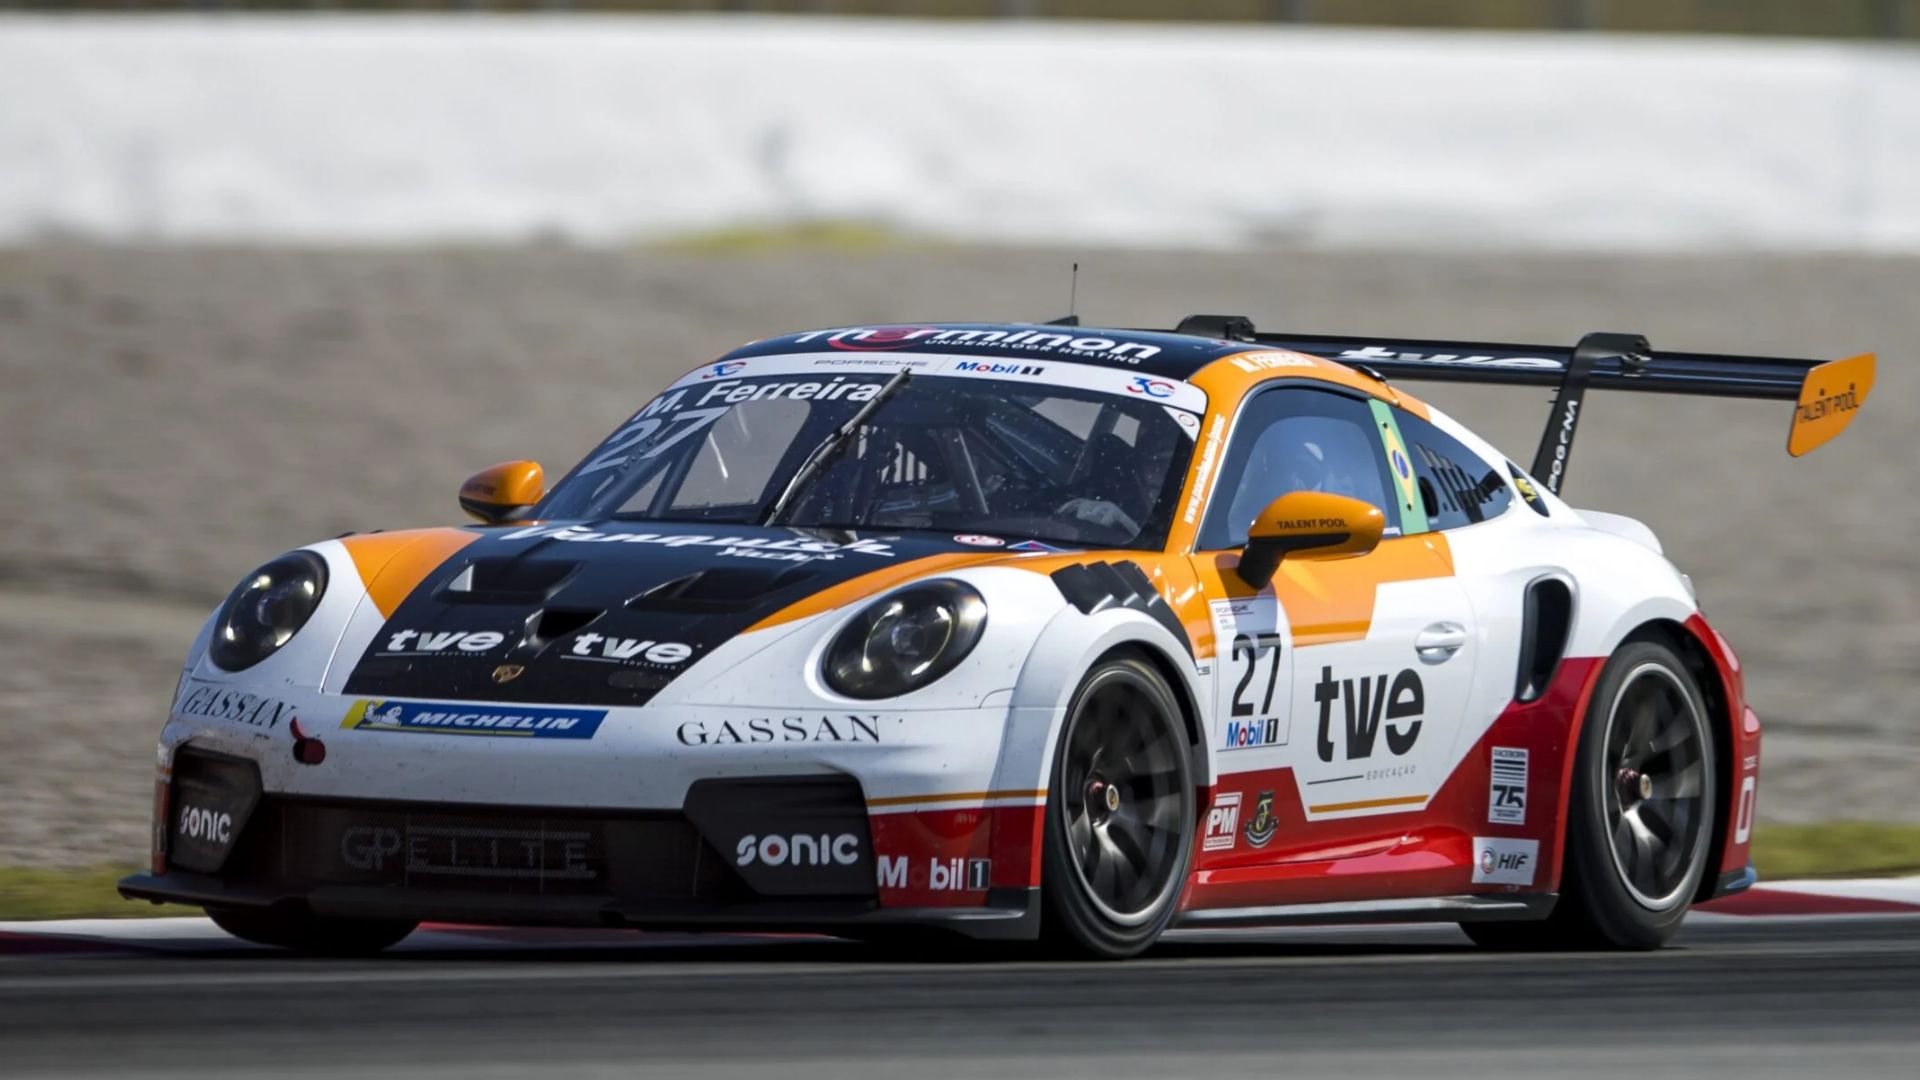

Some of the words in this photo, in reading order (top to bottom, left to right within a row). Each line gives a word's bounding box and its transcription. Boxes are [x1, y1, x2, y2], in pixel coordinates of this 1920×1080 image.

[814, 359, 928, 367] PORSCHE
[924, 338, 1051, 351] UNDERFLOOR
[1059, 347, 1141, 365] HEATING
[956, 361, 1020, 374] Mobil
[633, 389, 683, 422] M.
[697, 376, 884, 406] Ferreira
[1797, 397, 1833, 423] TALENT
[1833, 390, 1859, 414] POOL
[576, 405, 731, 477] 27
[1277, 519, 1317, 530] TALENT
[1319, 518, 1348, 529] POOL
[387, 629, 505, 652] twe
[572, 632, 692, 663] twe
[1231, 633, 1282, 717] 27
[182, 686, 299, 729] GASSAN
[411, 711, 580, 731] MICHELIN
[1314, 665, 1425, 763] twe
[676, 715, 881, 746] GASSAN
[1226, 719, 1264, 747] Mobil
[1265, 718, 1279, 743] 1
[1493, 784, 1525, 808] 75
[1207, 807, 1237, 836] PM
[341, 826, 400, 871] GP
[408, 836, 589, 872] ELITE
[1498, 853, 1528, 871] HIF
[967, 858, 992, 891] 1
